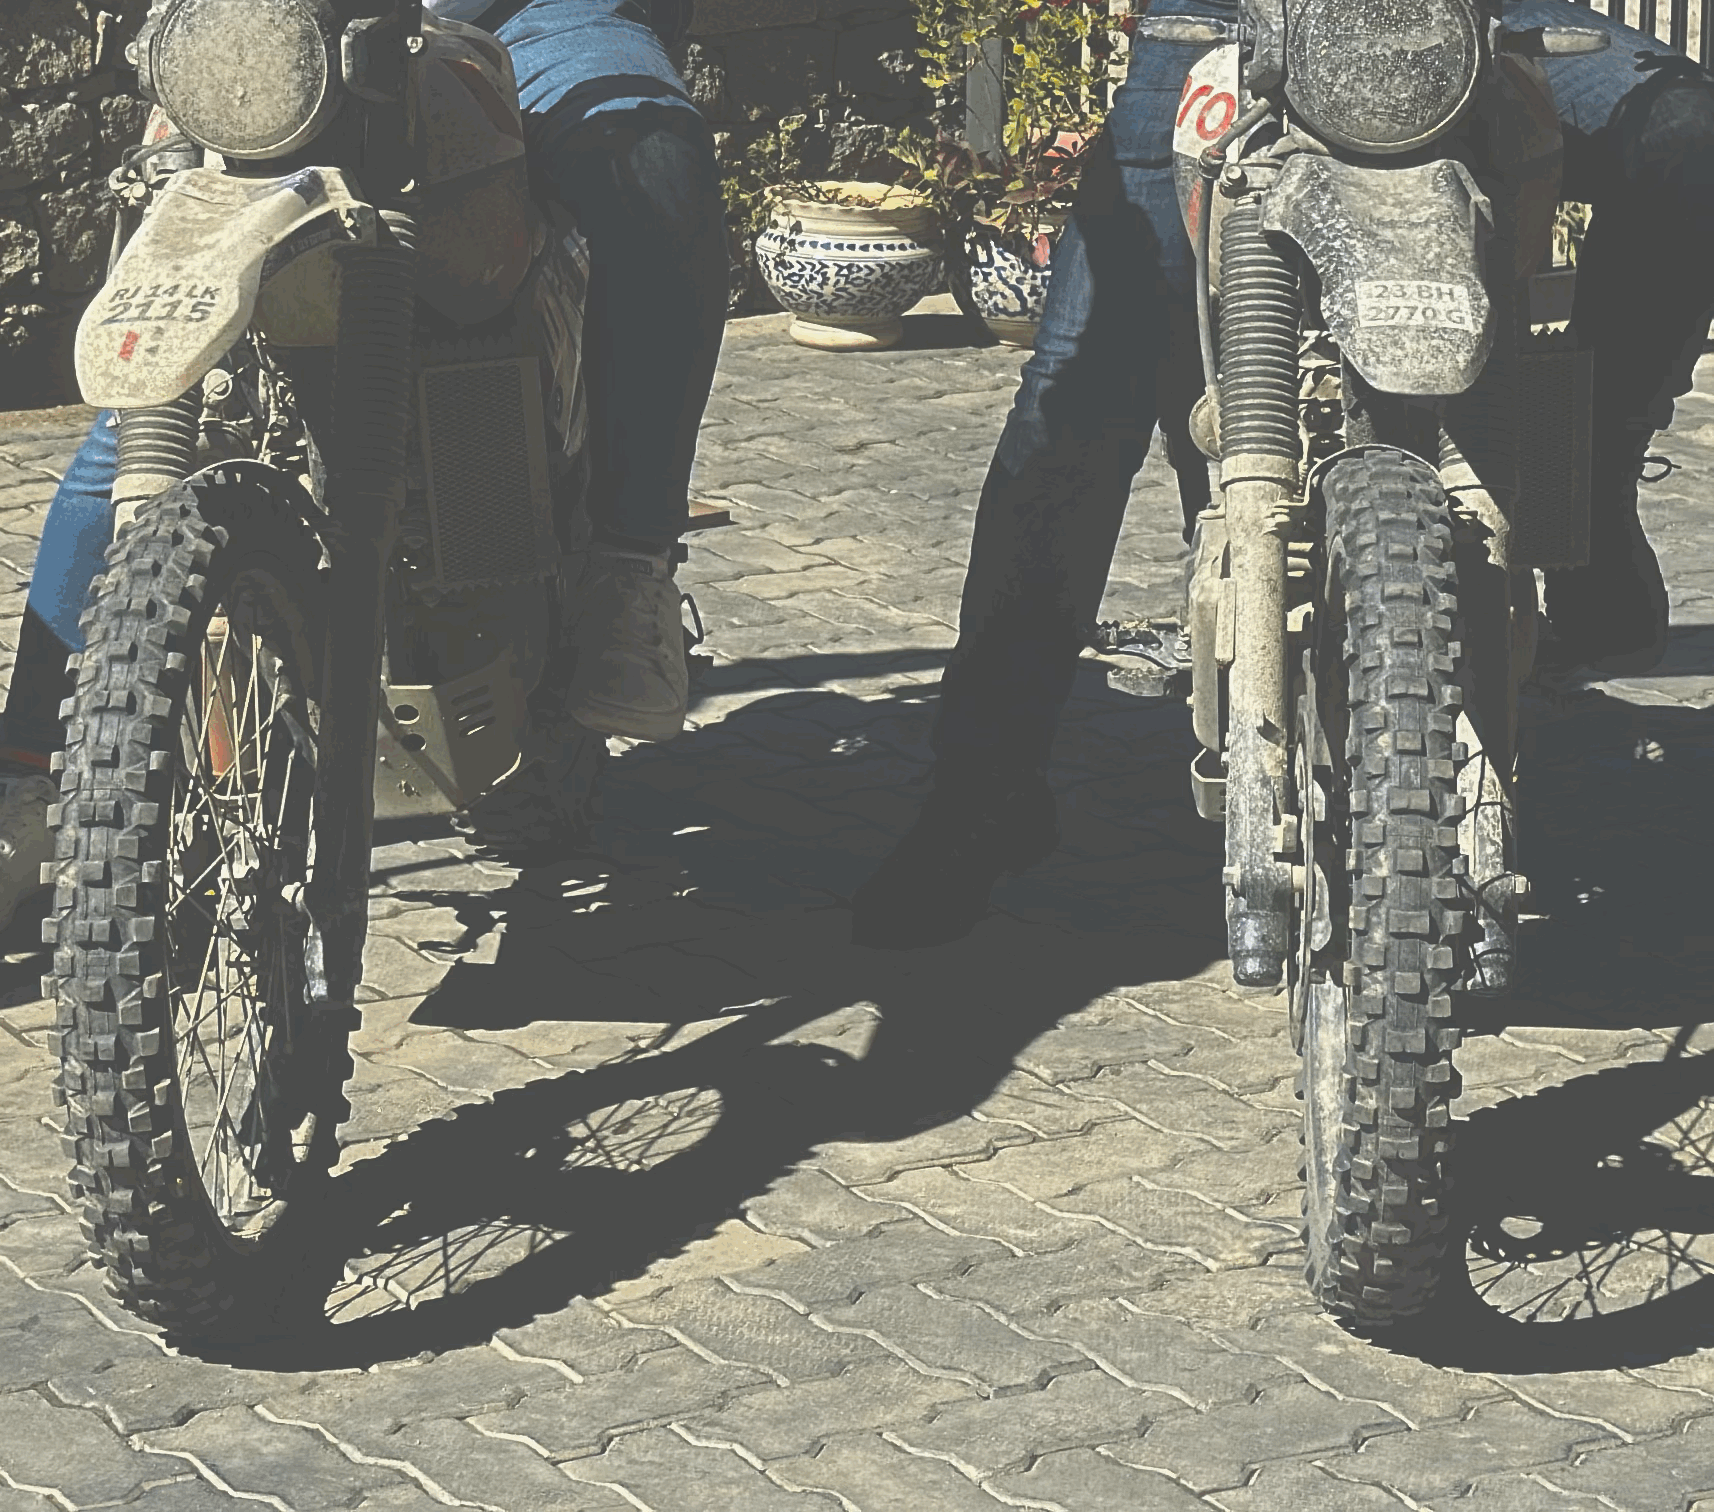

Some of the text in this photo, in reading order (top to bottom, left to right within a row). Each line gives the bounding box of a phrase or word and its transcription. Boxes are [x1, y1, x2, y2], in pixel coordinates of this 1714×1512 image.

[109, 286, 142, 303] RJ
[1417, 284, 1455, 302] BH
[100, 299, 215, 325] 2115
